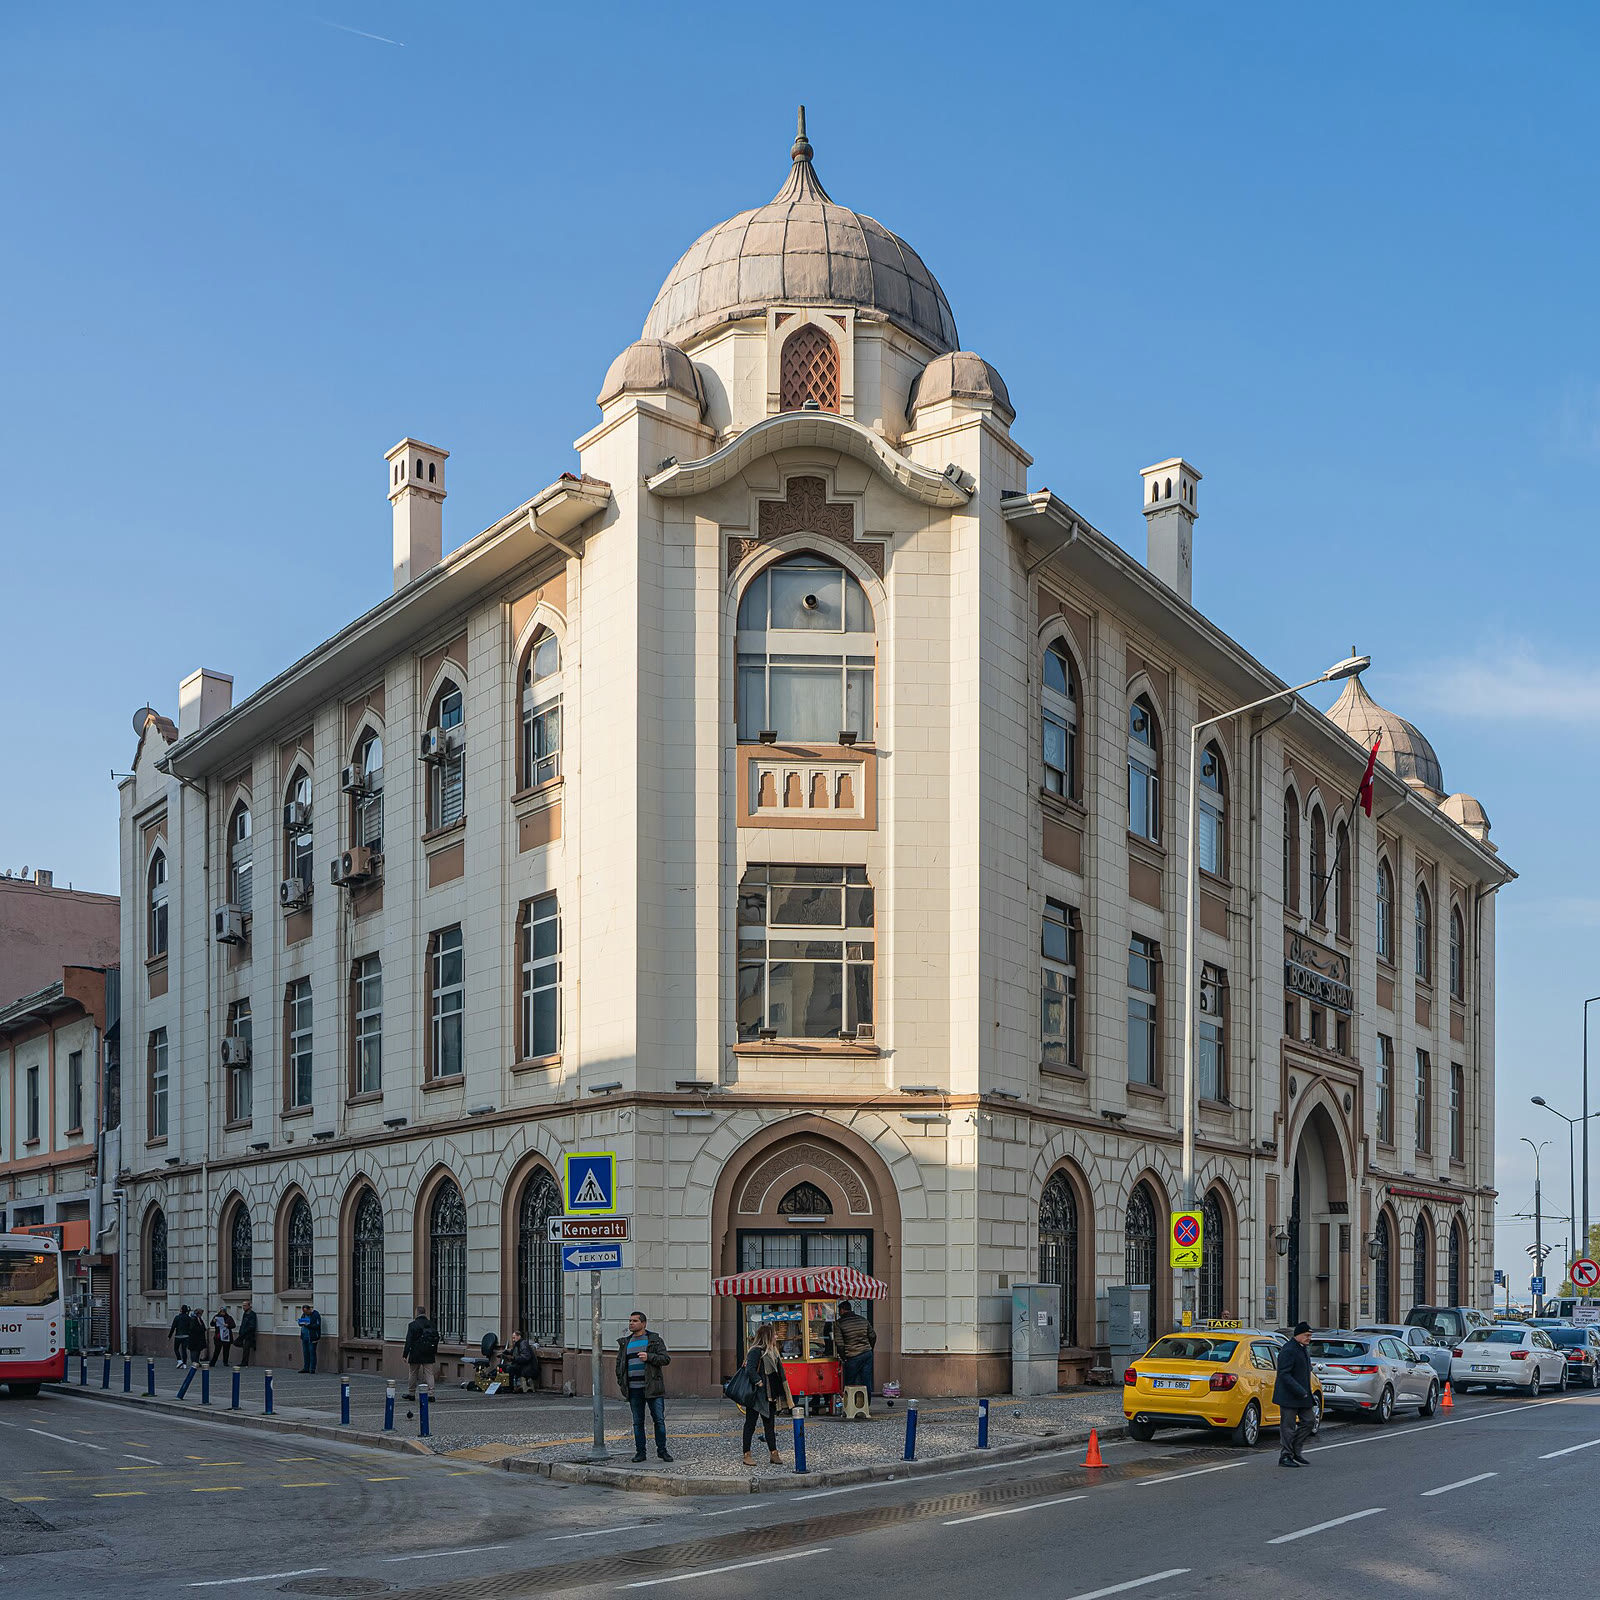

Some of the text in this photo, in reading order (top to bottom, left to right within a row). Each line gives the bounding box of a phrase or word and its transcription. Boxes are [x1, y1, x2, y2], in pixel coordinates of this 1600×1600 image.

[1291, 966, 1322, 997] BORSA
[564, 1223, 624, 1236] Kemeraltı
[33, 1256, 44, 1264] 39
[598, 1253, 616, 1261] YÖN
[0, 1323, 22, 1333] HOT
